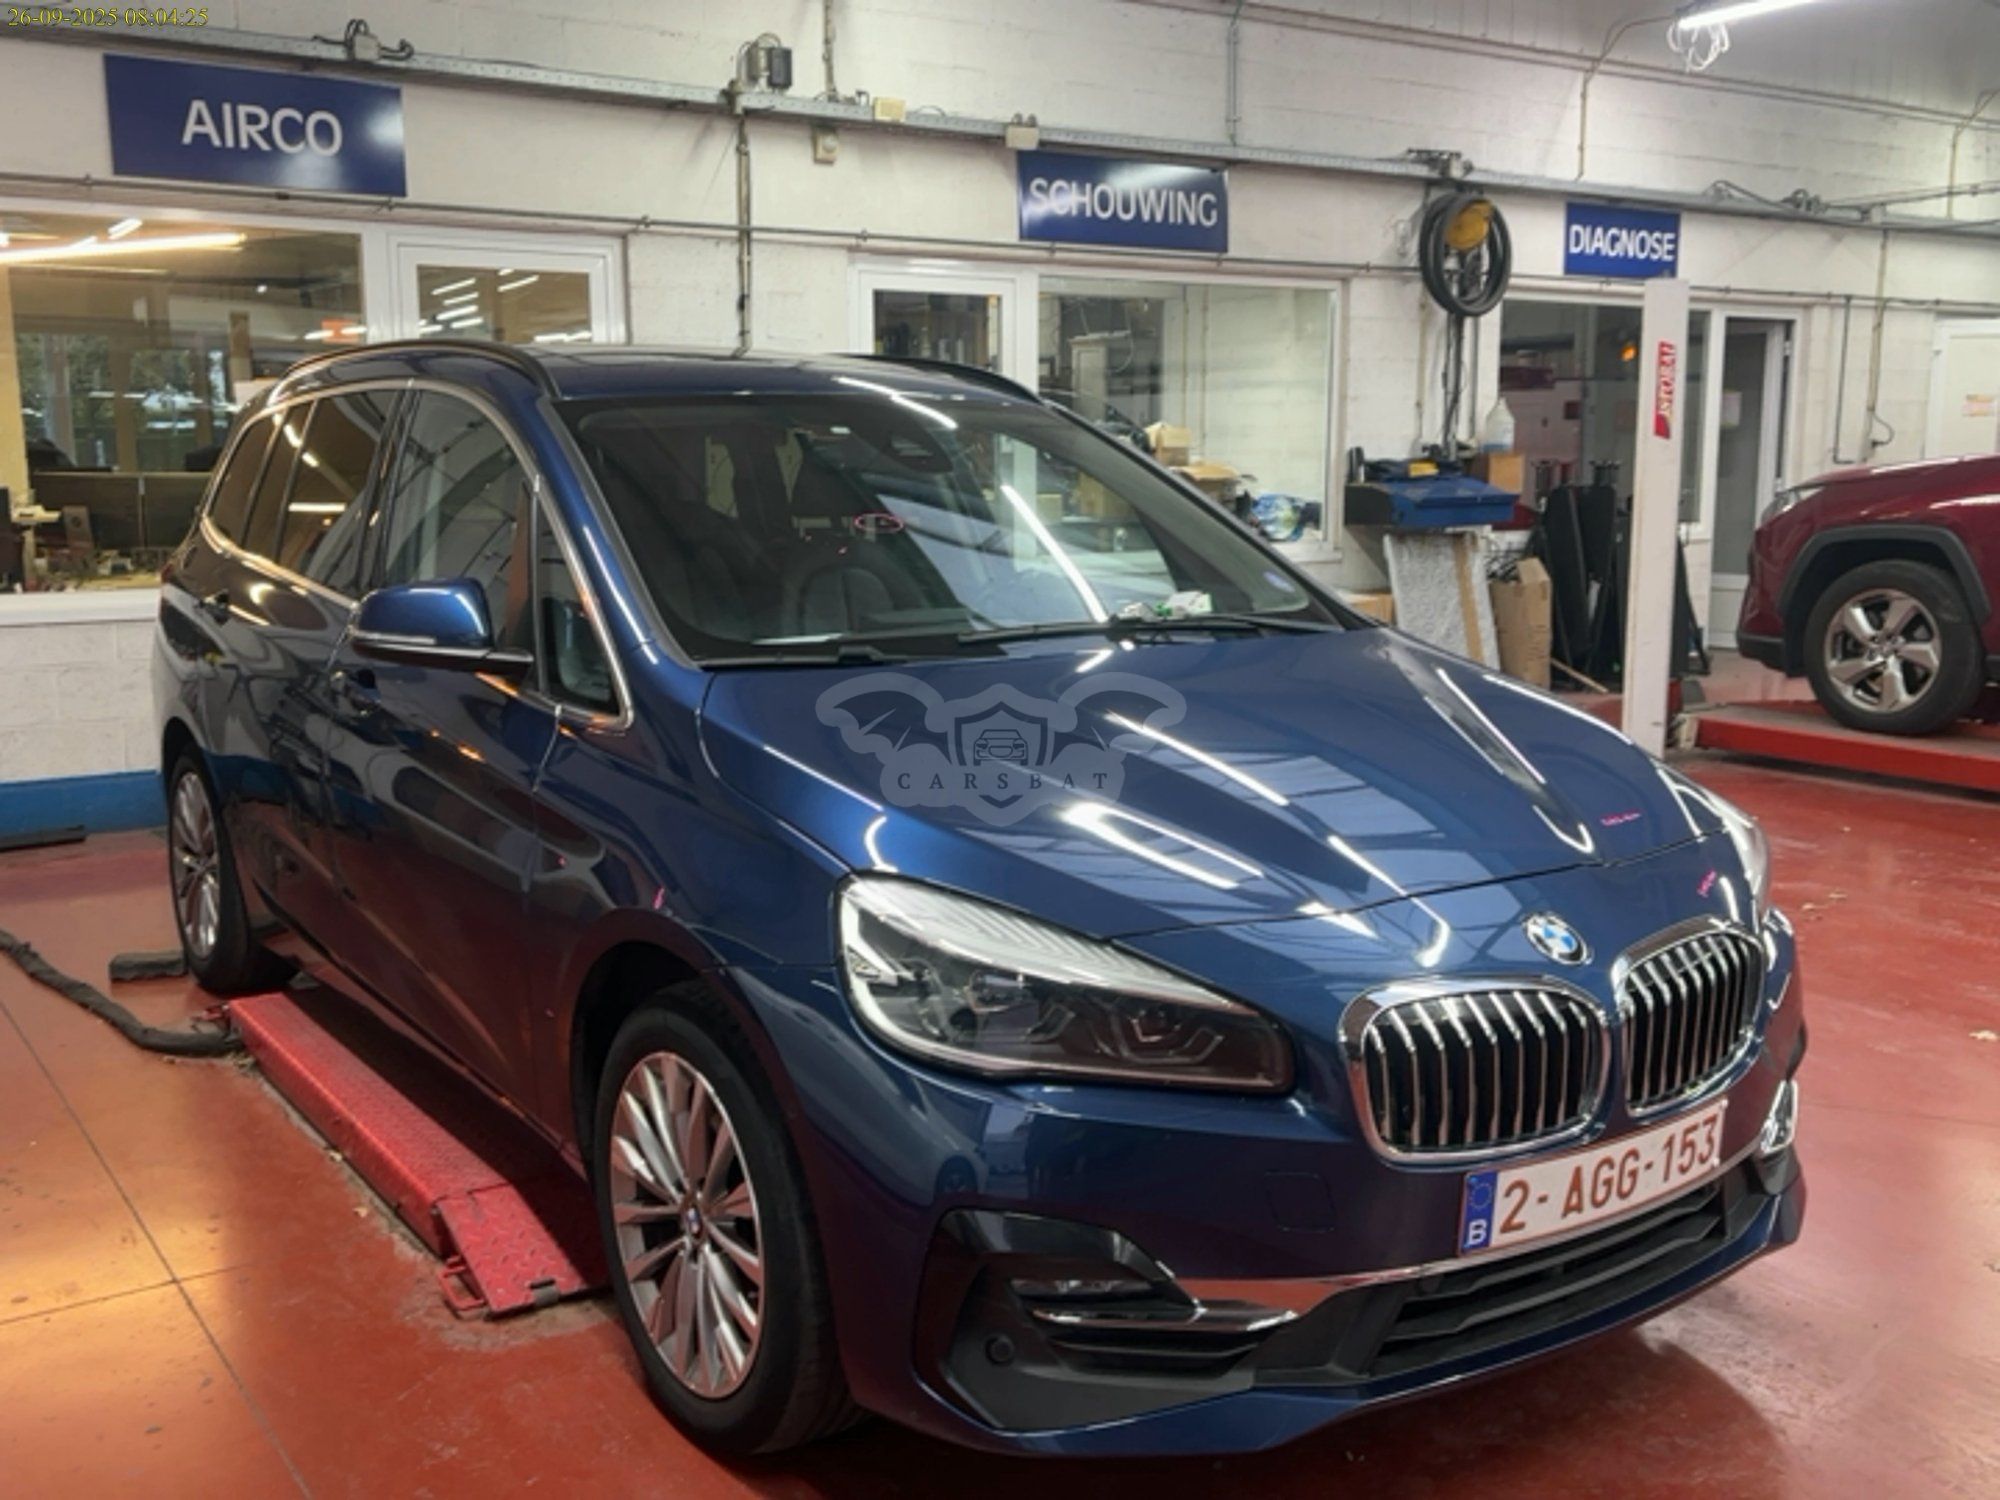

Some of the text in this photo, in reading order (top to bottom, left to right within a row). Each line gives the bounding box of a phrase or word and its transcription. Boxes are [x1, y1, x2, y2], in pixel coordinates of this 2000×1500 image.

[181, 99, 343, 156] AIRCO
[1029, 177, 1218, 227] SCHOUWING
[1569, 223, 1676, 262] DIAGNOSE
[1467, 1114, 1718, 1246] B 2-AGG-153
